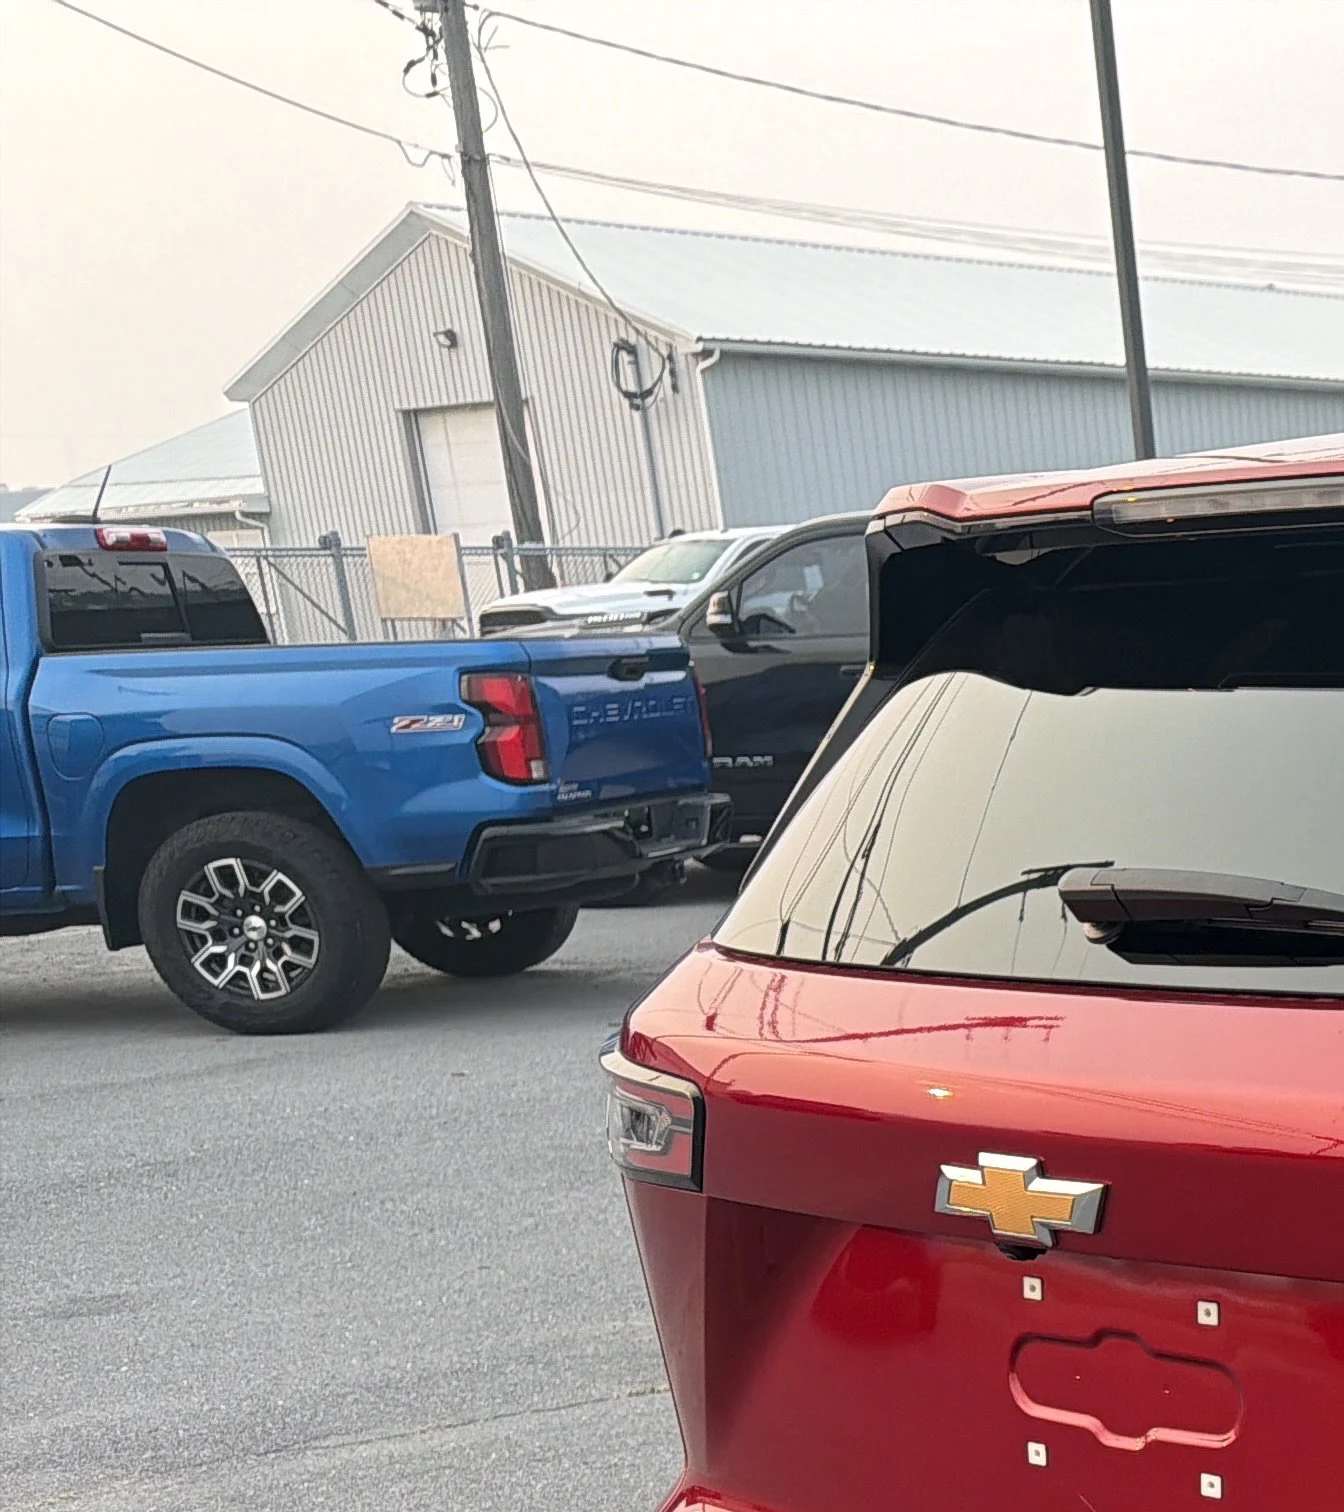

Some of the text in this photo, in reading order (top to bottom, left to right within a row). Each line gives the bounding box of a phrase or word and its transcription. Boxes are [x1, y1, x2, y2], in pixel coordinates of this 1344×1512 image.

[572, 697, 694, 726] CHEVROLET
[390, 713, 466, 733] Z71
[712, 755, 774, 769] RAM
